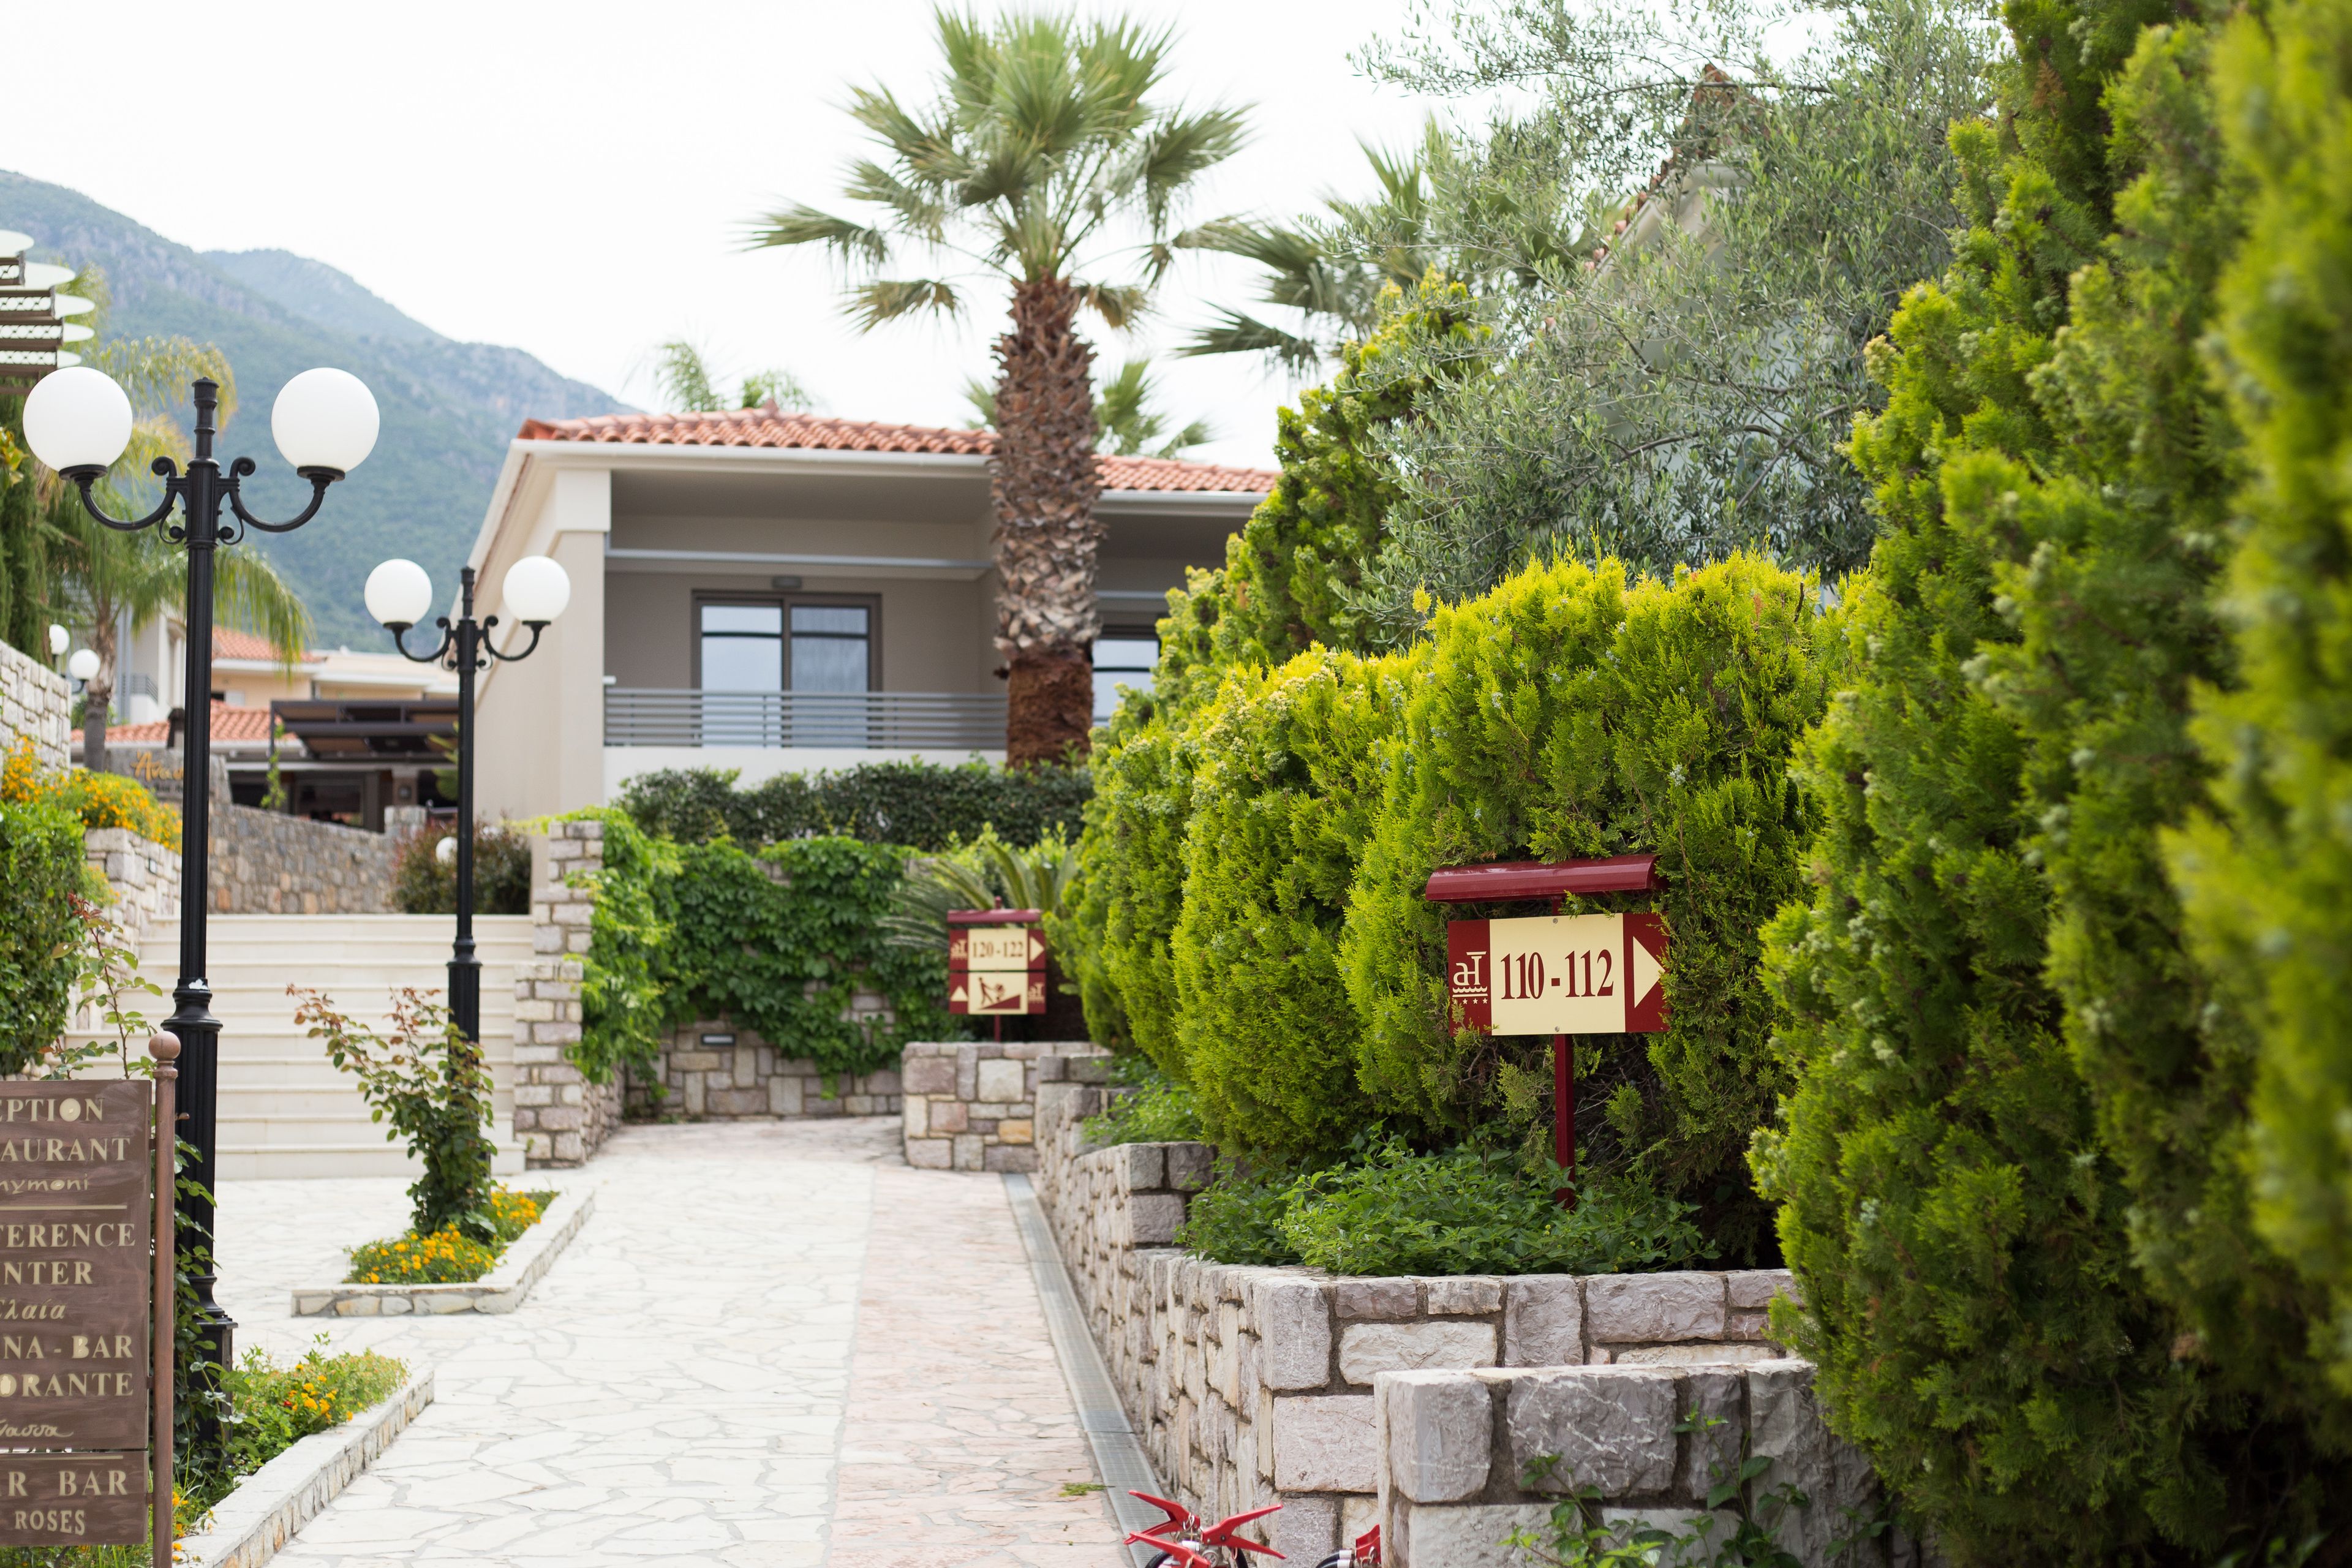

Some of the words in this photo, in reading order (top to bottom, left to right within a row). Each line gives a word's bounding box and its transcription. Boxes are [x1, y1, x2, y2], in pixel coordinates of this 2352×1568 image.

[1500, 949, 1614, 1000] 110-112
[0, 1098, 105, 1122] PTION
[1, 1138, 130, 1162] AURANT
[0, 1223, 135, 1248] ERENCE
[4, 1262, 92, 1284] NTER
[72, 1335, 134, 1359] BAR
[0, 1373, 134, 1398] ORANTE
[59, 1470, 127, 1496] BAR
[15, 1510, 86, 1536] ROSES
